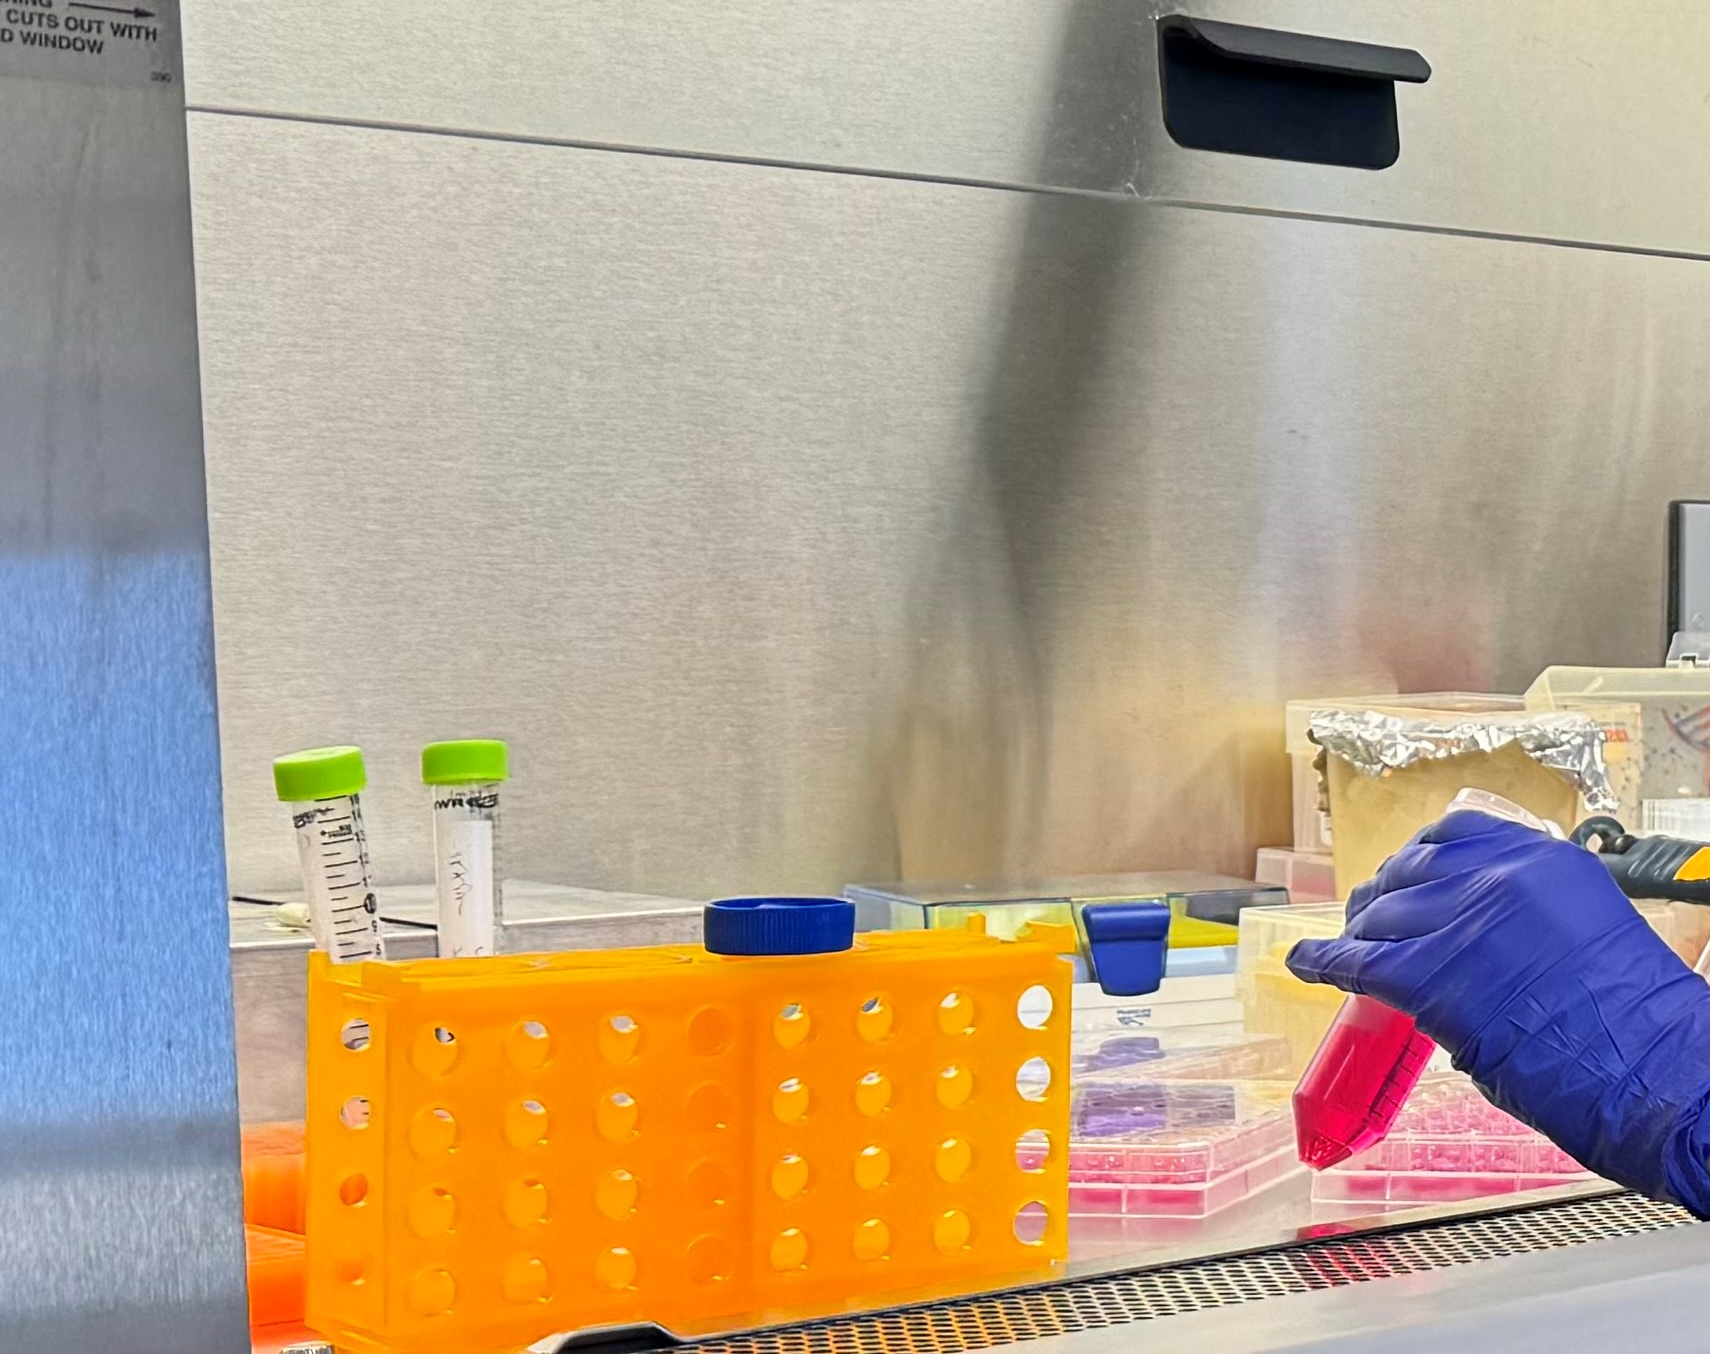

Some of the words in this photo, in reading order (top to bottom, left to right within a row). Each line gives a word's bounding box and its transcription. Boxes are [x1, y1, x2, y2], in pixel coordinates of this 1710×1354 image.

[6, 9, 59, 29] CUTS
[64, 16, 105, 34] OUT
[110, 22, 157, 41] WITH
[20, 31, 104, 54] WINDOW
